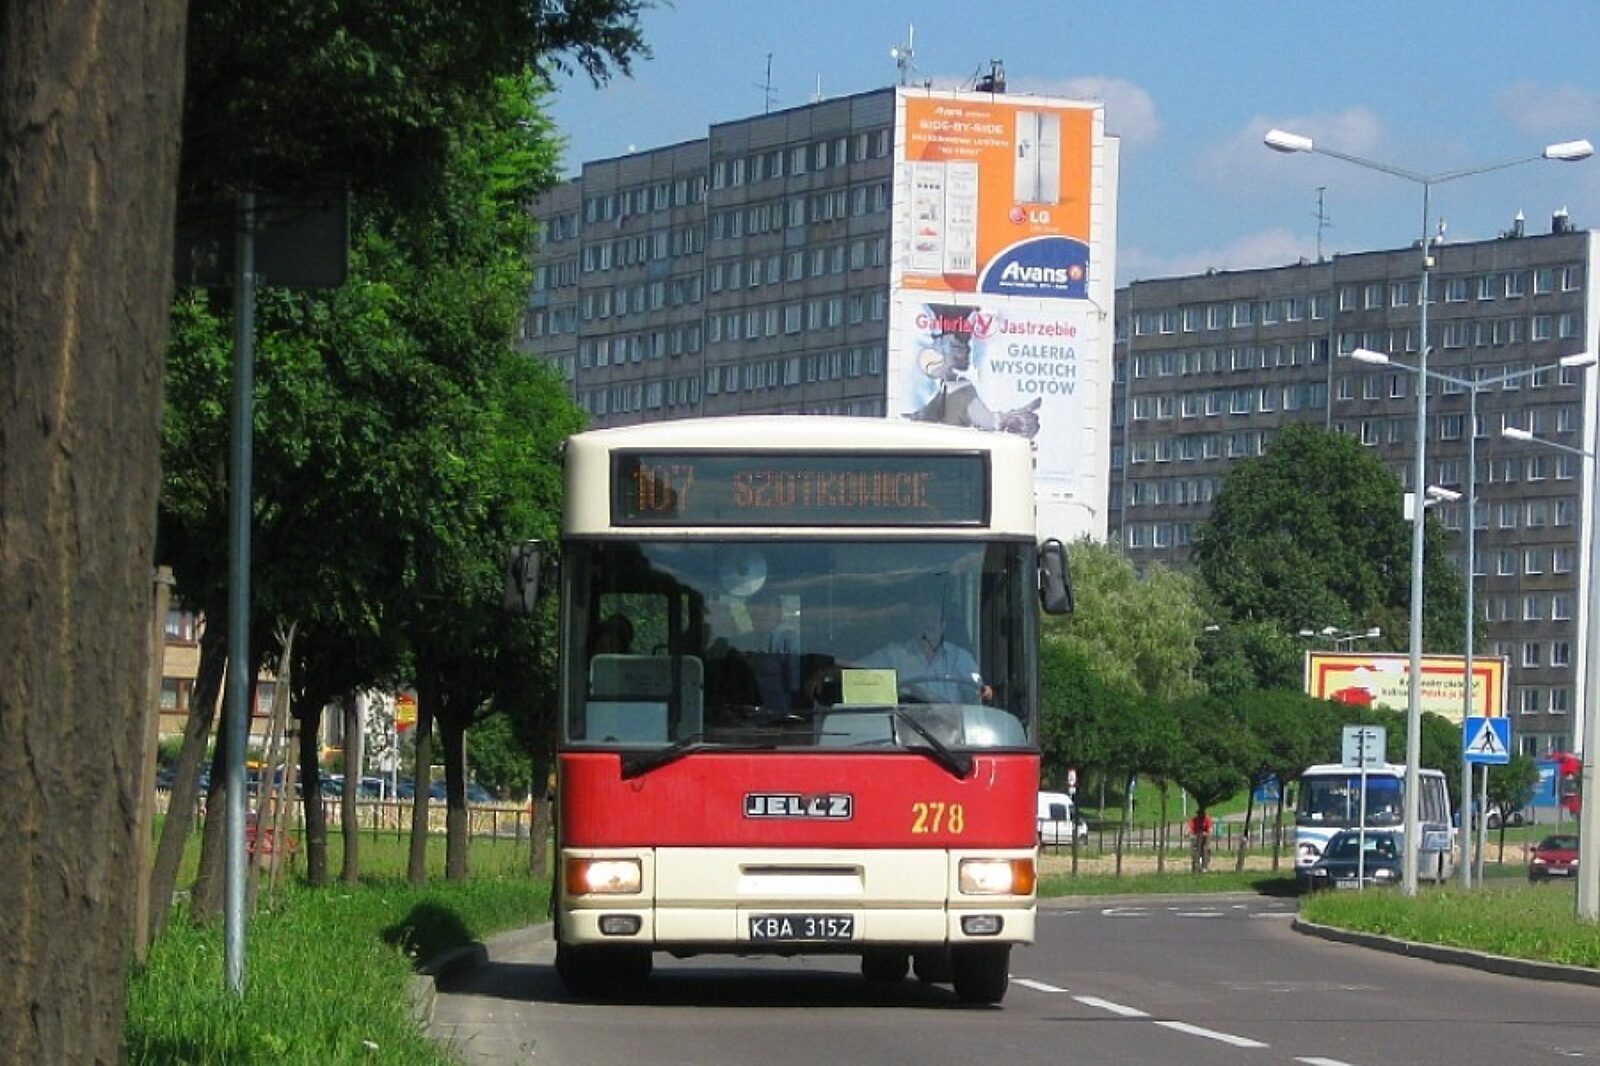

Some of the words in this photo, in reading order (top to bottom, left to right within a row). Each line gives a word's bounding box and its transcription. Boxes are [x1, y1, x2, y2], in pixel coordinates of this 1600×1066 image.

[1029, 209, 1050, 224] LG
[1001, 260, 1068, 283] Avans
[915, 313, 975, 333] Galeria
[1007, 343, 1075, 361] GALERIA
[990, 359, 1077, 378] WYSOKICH
[1017, 377, 1075, 395] LOTÓW
[632, 464, 694, 512] 107
[911, 802, 965, 834] 278
[751, 918, 794, 938] KBA
